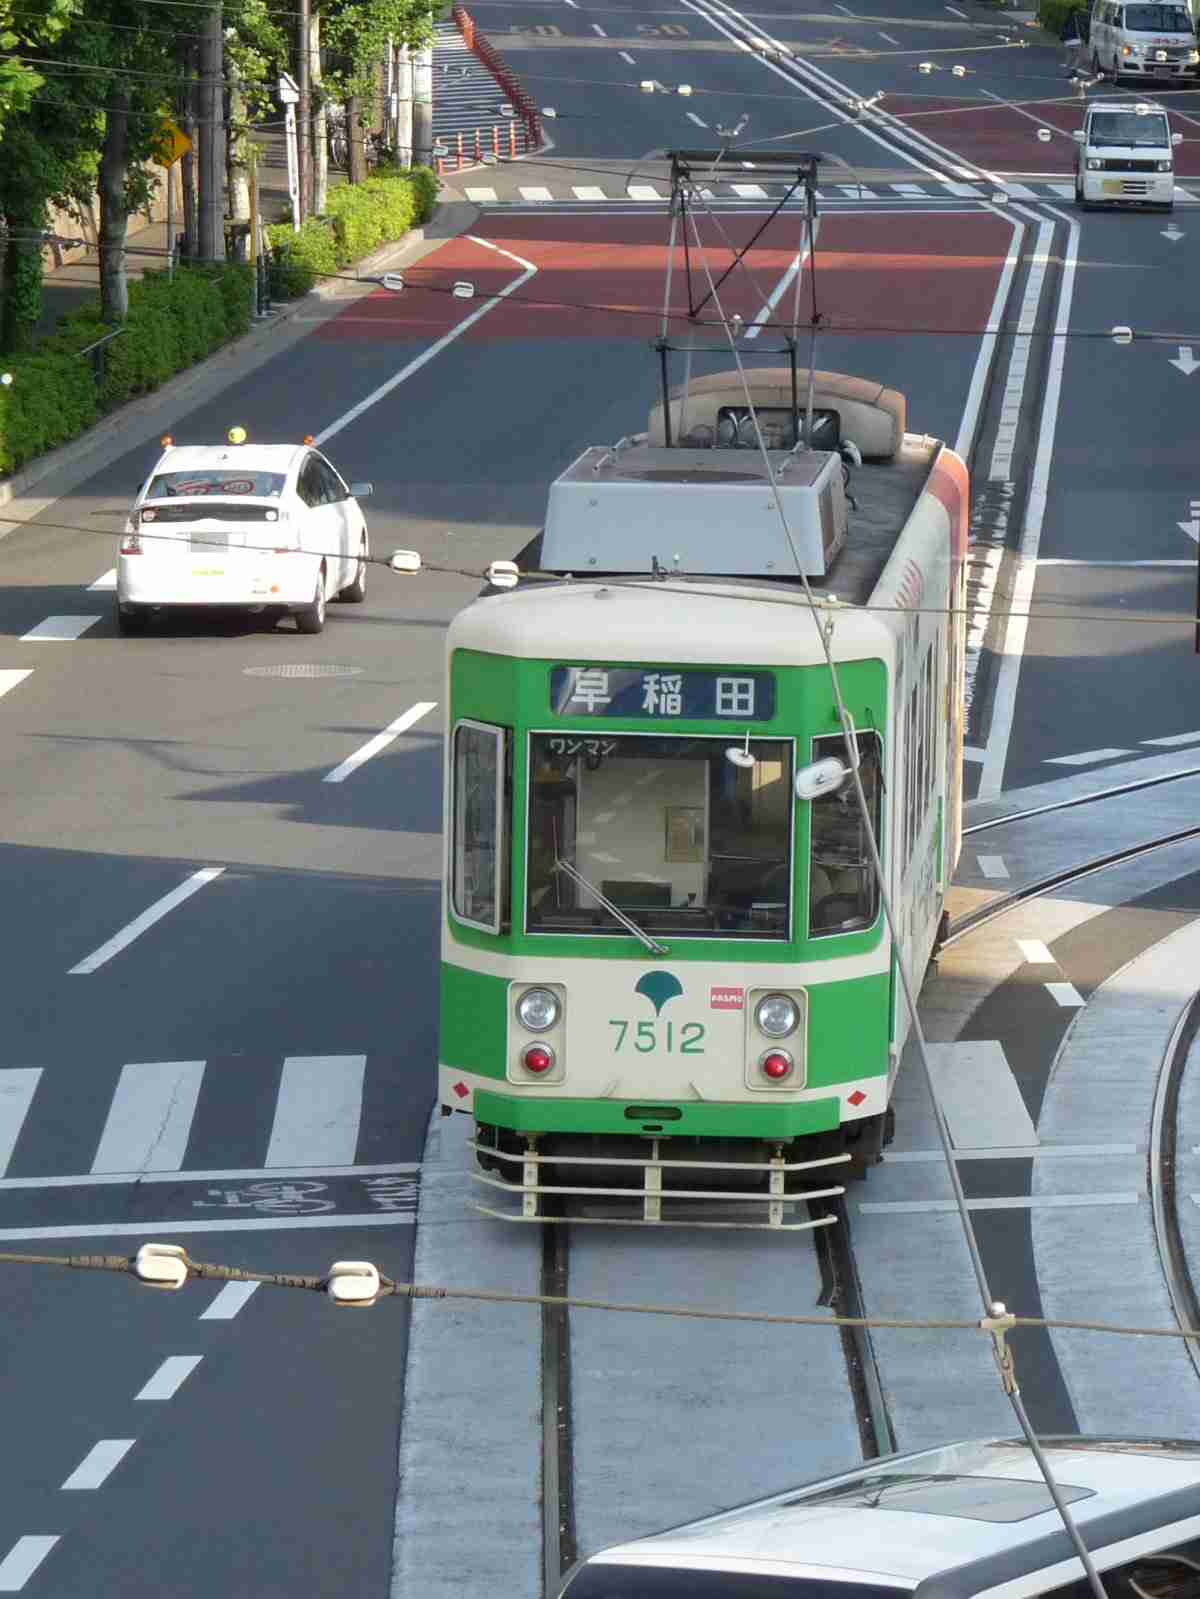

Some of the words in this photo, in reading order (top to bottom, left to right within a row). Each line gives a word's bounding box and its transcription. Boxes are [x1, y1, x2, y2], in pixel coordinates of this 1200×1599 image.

[570, 670, 756, 716] 早稲田
[549, 738, 617, 755] ワンマン
[608, 1020, 705, 1053] 7512
